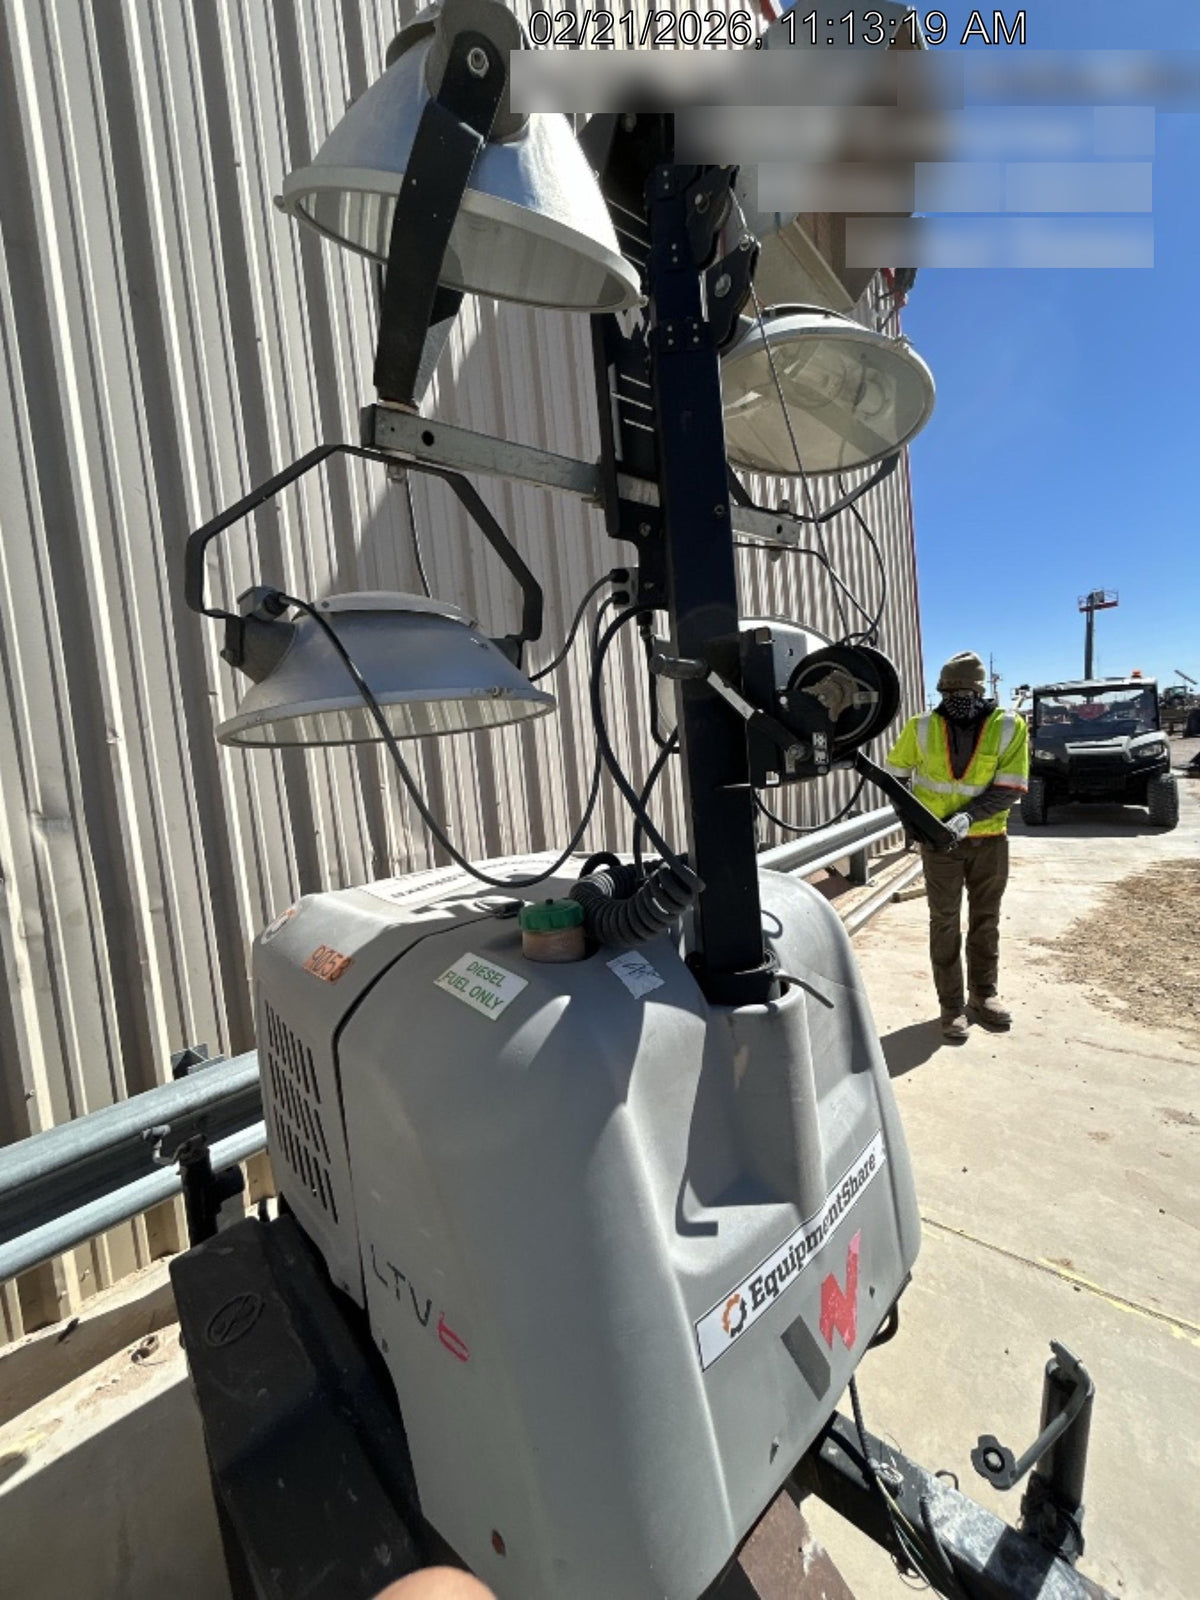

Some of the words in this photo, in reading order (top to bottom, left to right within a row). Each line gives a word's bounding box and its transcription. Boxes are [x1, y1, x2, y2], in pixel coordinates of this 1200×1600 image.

[442, 970, 470, 992] FUEL
[469, 986, 504, 1010] ONLY
[466, 961, 506, 987] DIESEL
[750, 1153, 876, 1311] EquipmentShare
